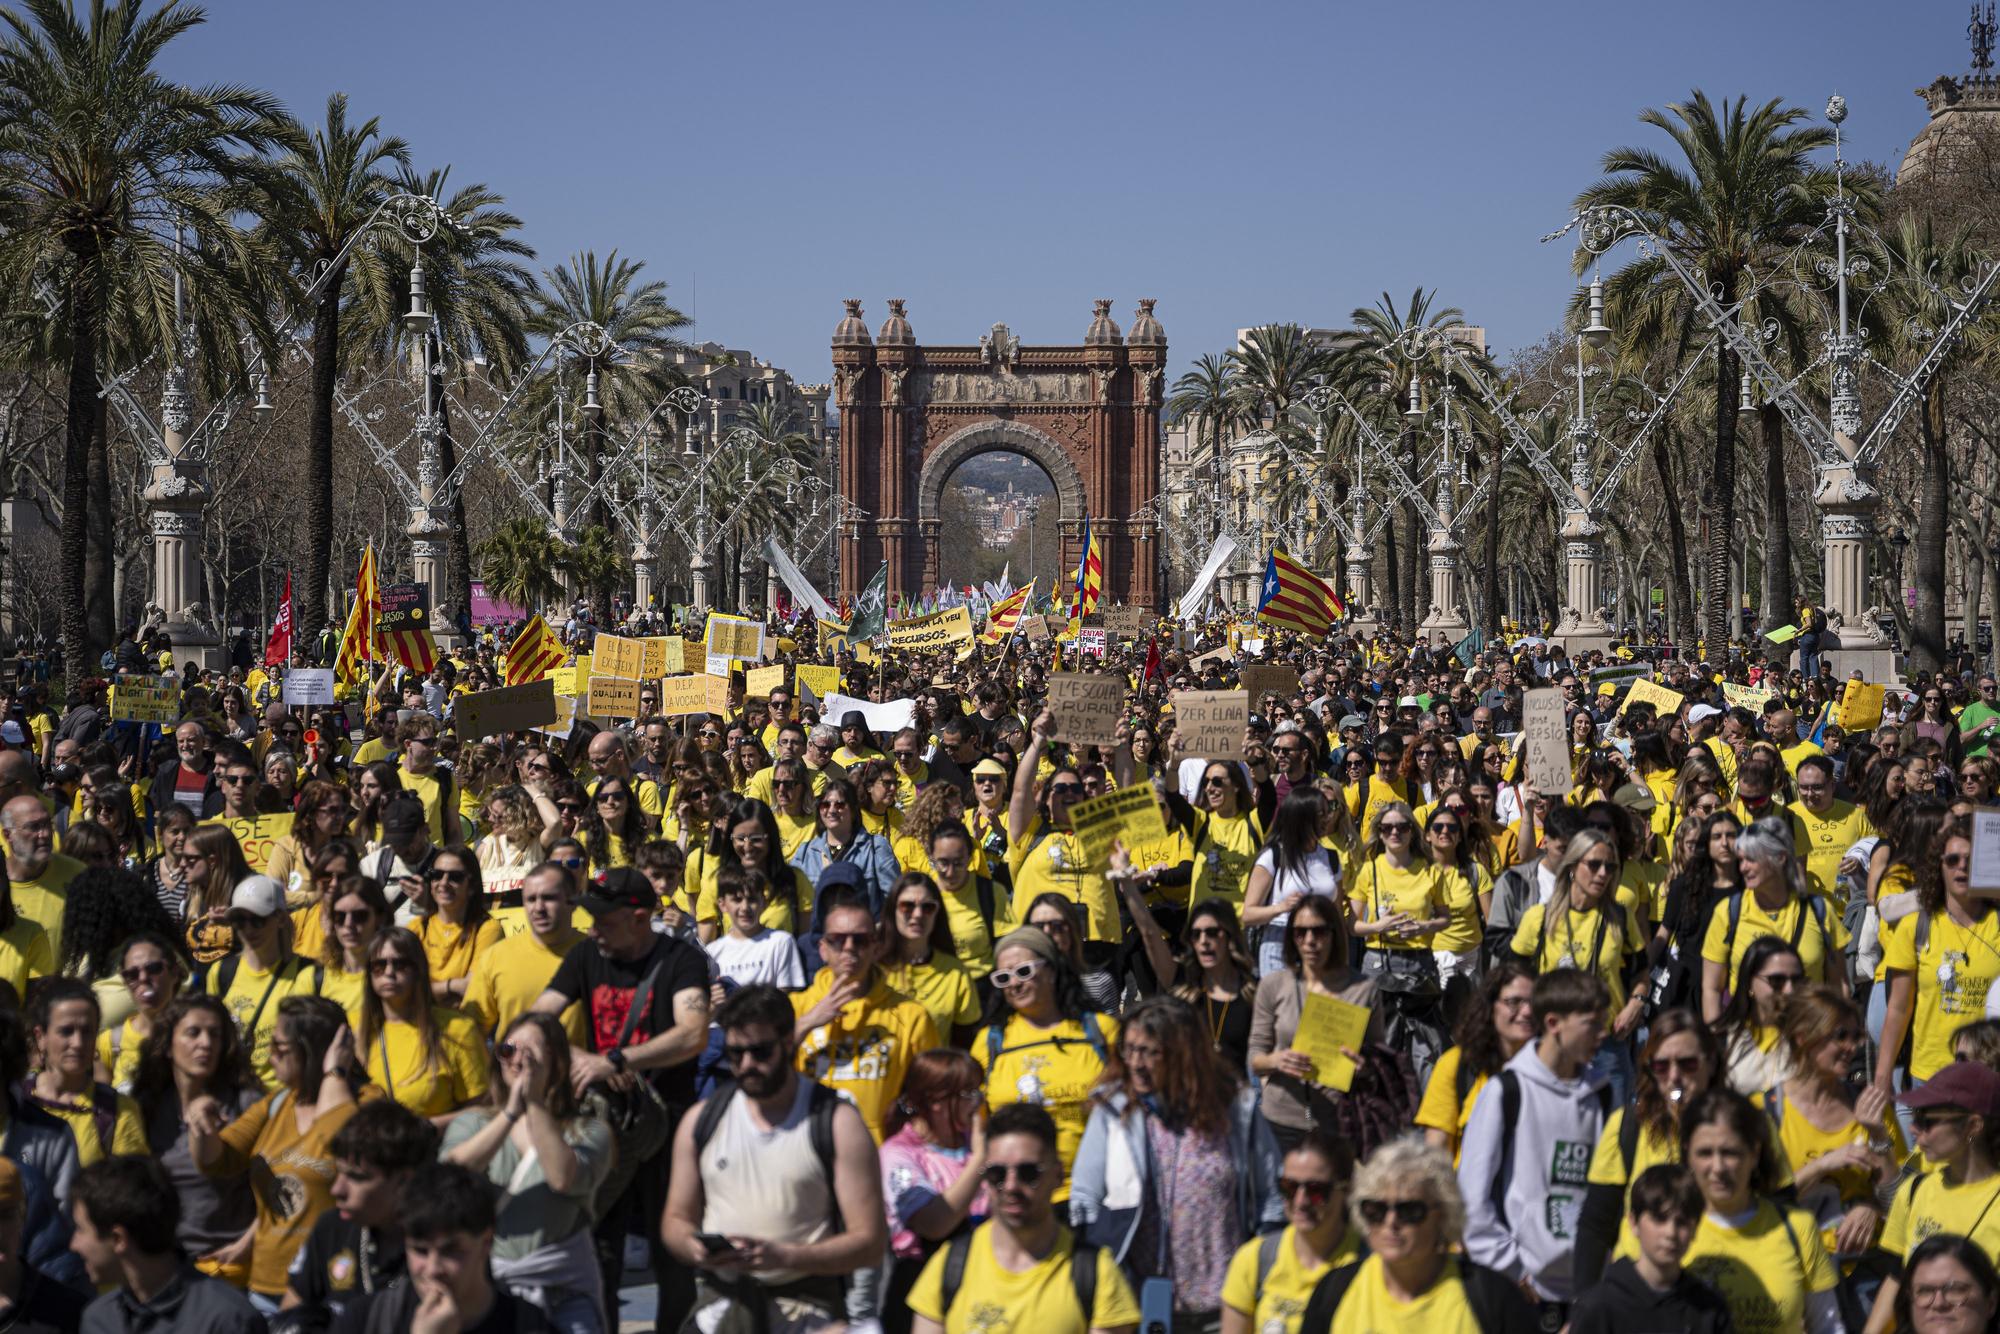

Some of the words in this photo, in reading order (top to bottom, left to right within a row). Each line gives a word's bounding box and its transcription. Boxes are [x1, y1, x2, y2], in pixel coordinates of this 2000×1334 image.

[381, 611, 405, 623] URSOS
[932, 617, 944, 625] LA
[946, 612, 961, 621] VEU
[607, 640, 616, 652] EL
[601, 656, 634, 673] EXISTEIX
[675, 679, 695, 690] D.E.P.
[1058, 680, 1117, 700] L'ESCOLA
[665, 698, 674, 708] LA
[675, 692, 706, 707] VOCACIÓ
[1204, 695, 1217, 704] LA
[1062, 700, 1117, 716] RURAL
[1181, 706, 1206, 721] ZER
[1200, 725, 1239, 735] TAMPOC
[1183, 736, 1230, 753] CALLA
[1811, 821, 1838, 832] SOS
[1144, 850, 1170, 862] SOS
[1557, 1142, 1589, 1161] JO
